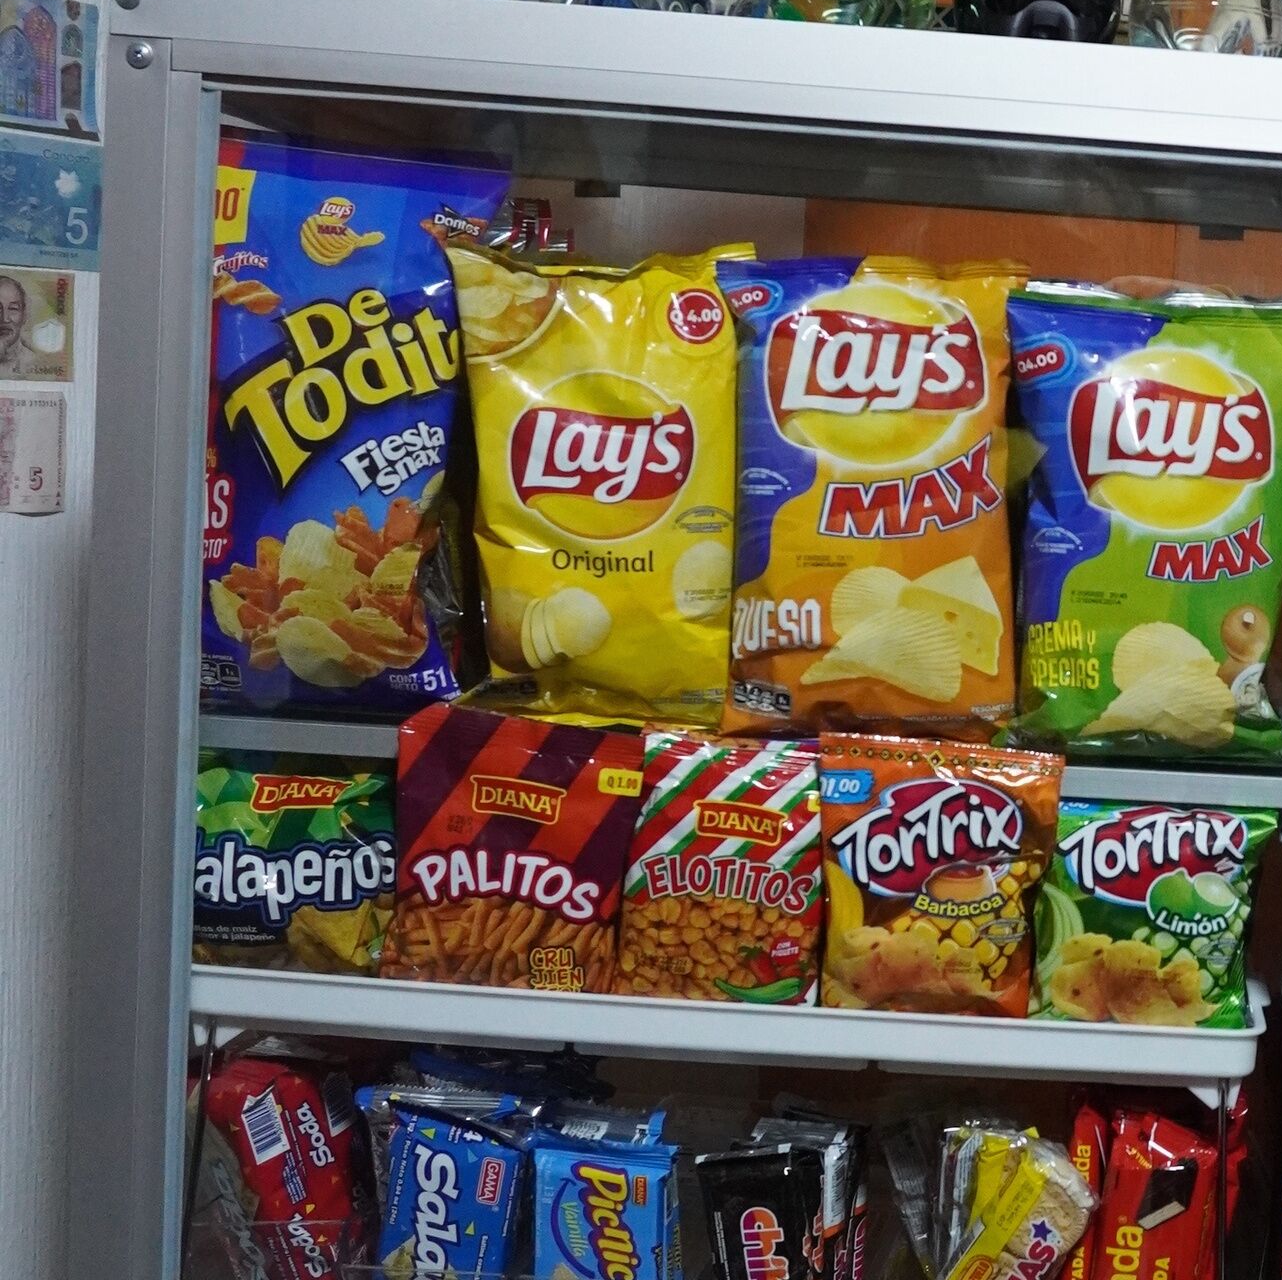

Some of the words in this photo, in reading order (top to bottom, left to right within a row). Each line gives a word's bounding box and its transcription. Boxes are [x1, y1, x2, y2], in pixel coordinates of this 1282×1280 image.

[65, 206, 90, 246] 5
[317, 223, 350, 238] MAX
[780, 314, 973, 412] Lay's
[340, 421, 446, 493] Fiesta
[520, 407, 686, 505] Lay's
[1087, 380, 1257, 478] Lay's
[29, 465, 44, 492] 5
[817, 432, 1004, 539] MAX
[551, 548, 657, 580] Original
[1145, 514, 1274, 583] MAX
[732, 598, 822, 660] QUESO
[257, 783, 337, 805] DIANA
[479, 787, 553, 816] DIANA
[617, 777, 638, 791] 1.00
[412, 849, 600, 920] PALITOS
[644, 855, 816, 914] ELOTITOS
[913, 892, 1004, 919] Barbacoa
[1154, 908, 1227, 936] Limón
[296, 1101, 335, 1168] Soda
[560, 1201, 587, 1258] Vainilla
